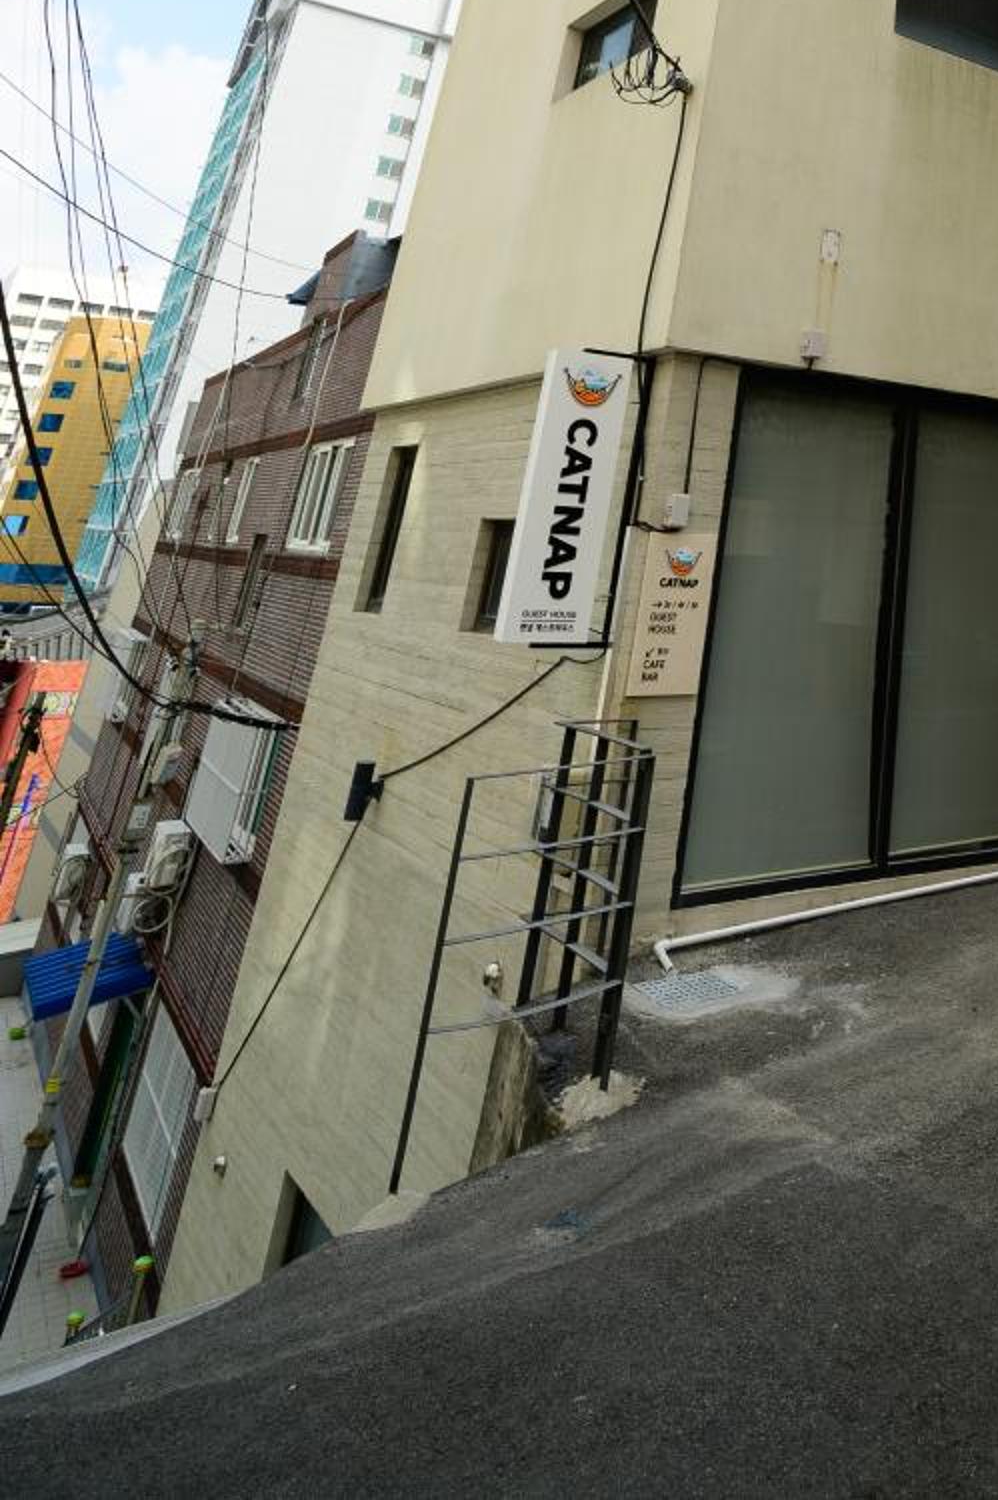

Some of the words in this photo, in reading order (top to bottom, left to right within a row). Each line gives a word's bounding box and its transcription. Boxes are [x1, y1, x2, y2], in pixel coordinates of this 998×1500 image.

[541, 418, 598, 600] CATNAP
[659, 577, 699, 588] CATNAP
[643, 660, 665, 670] CAFE
